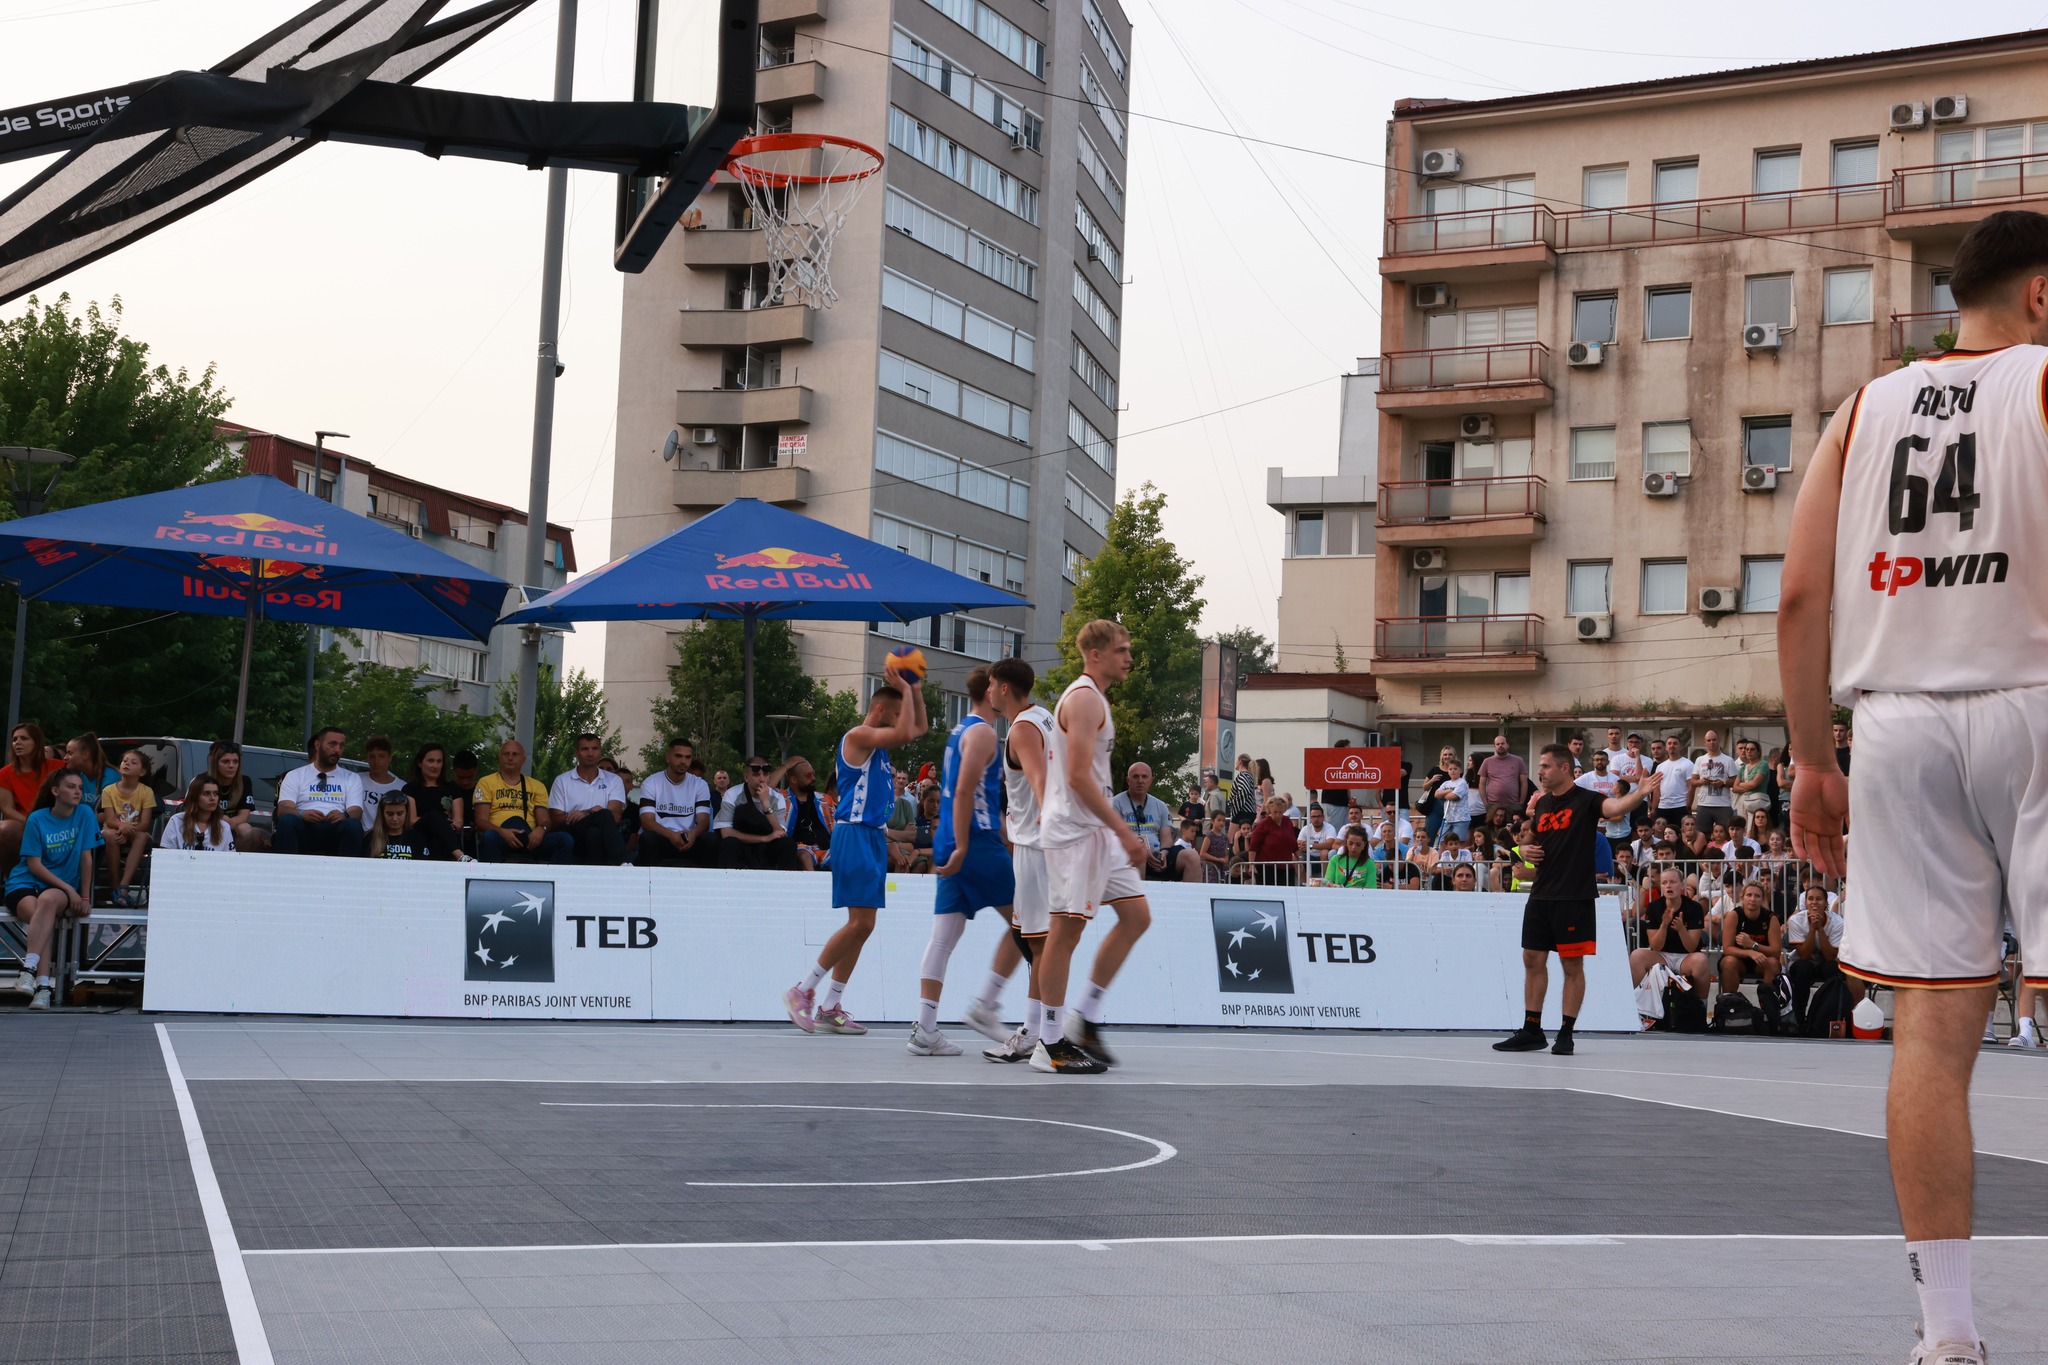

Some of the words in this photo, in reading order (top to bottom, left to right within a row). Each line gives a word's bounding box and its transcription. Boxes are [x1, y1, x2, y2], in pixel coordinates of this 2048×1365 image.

[36, 95, 132, 128] Sports
[66, 118, 100, 131] Superior
[1888, 431, 1981, 536] 64
[154, 525, 247, 546] Red
[252, 533, 339, 556] Bull
[704, 571, 790, 590] Red
[791, 571, 873, 590] Bull
[1330, 770, 1377, 779] vitaminka
[669, 802, 694, 813] Angeles
[565, 915, 659, 949] TEB
[1297, 932, 1377, 964] TEB
[464, 994, 488, 1006] BNP
[492, 995, 541, 1007] PARIBAS
[545, 995, 577, 1008] JOINT
[581, 996, 631, 1008] VENTURE
[1221, 1004, 1242, 1015] BNP
[1245, 1005, 1286, 1016] PARIBAS
[1289, 1005, 1315, 1017] JOINT
[1318, 1006, 1361, 1018] VENTURE
